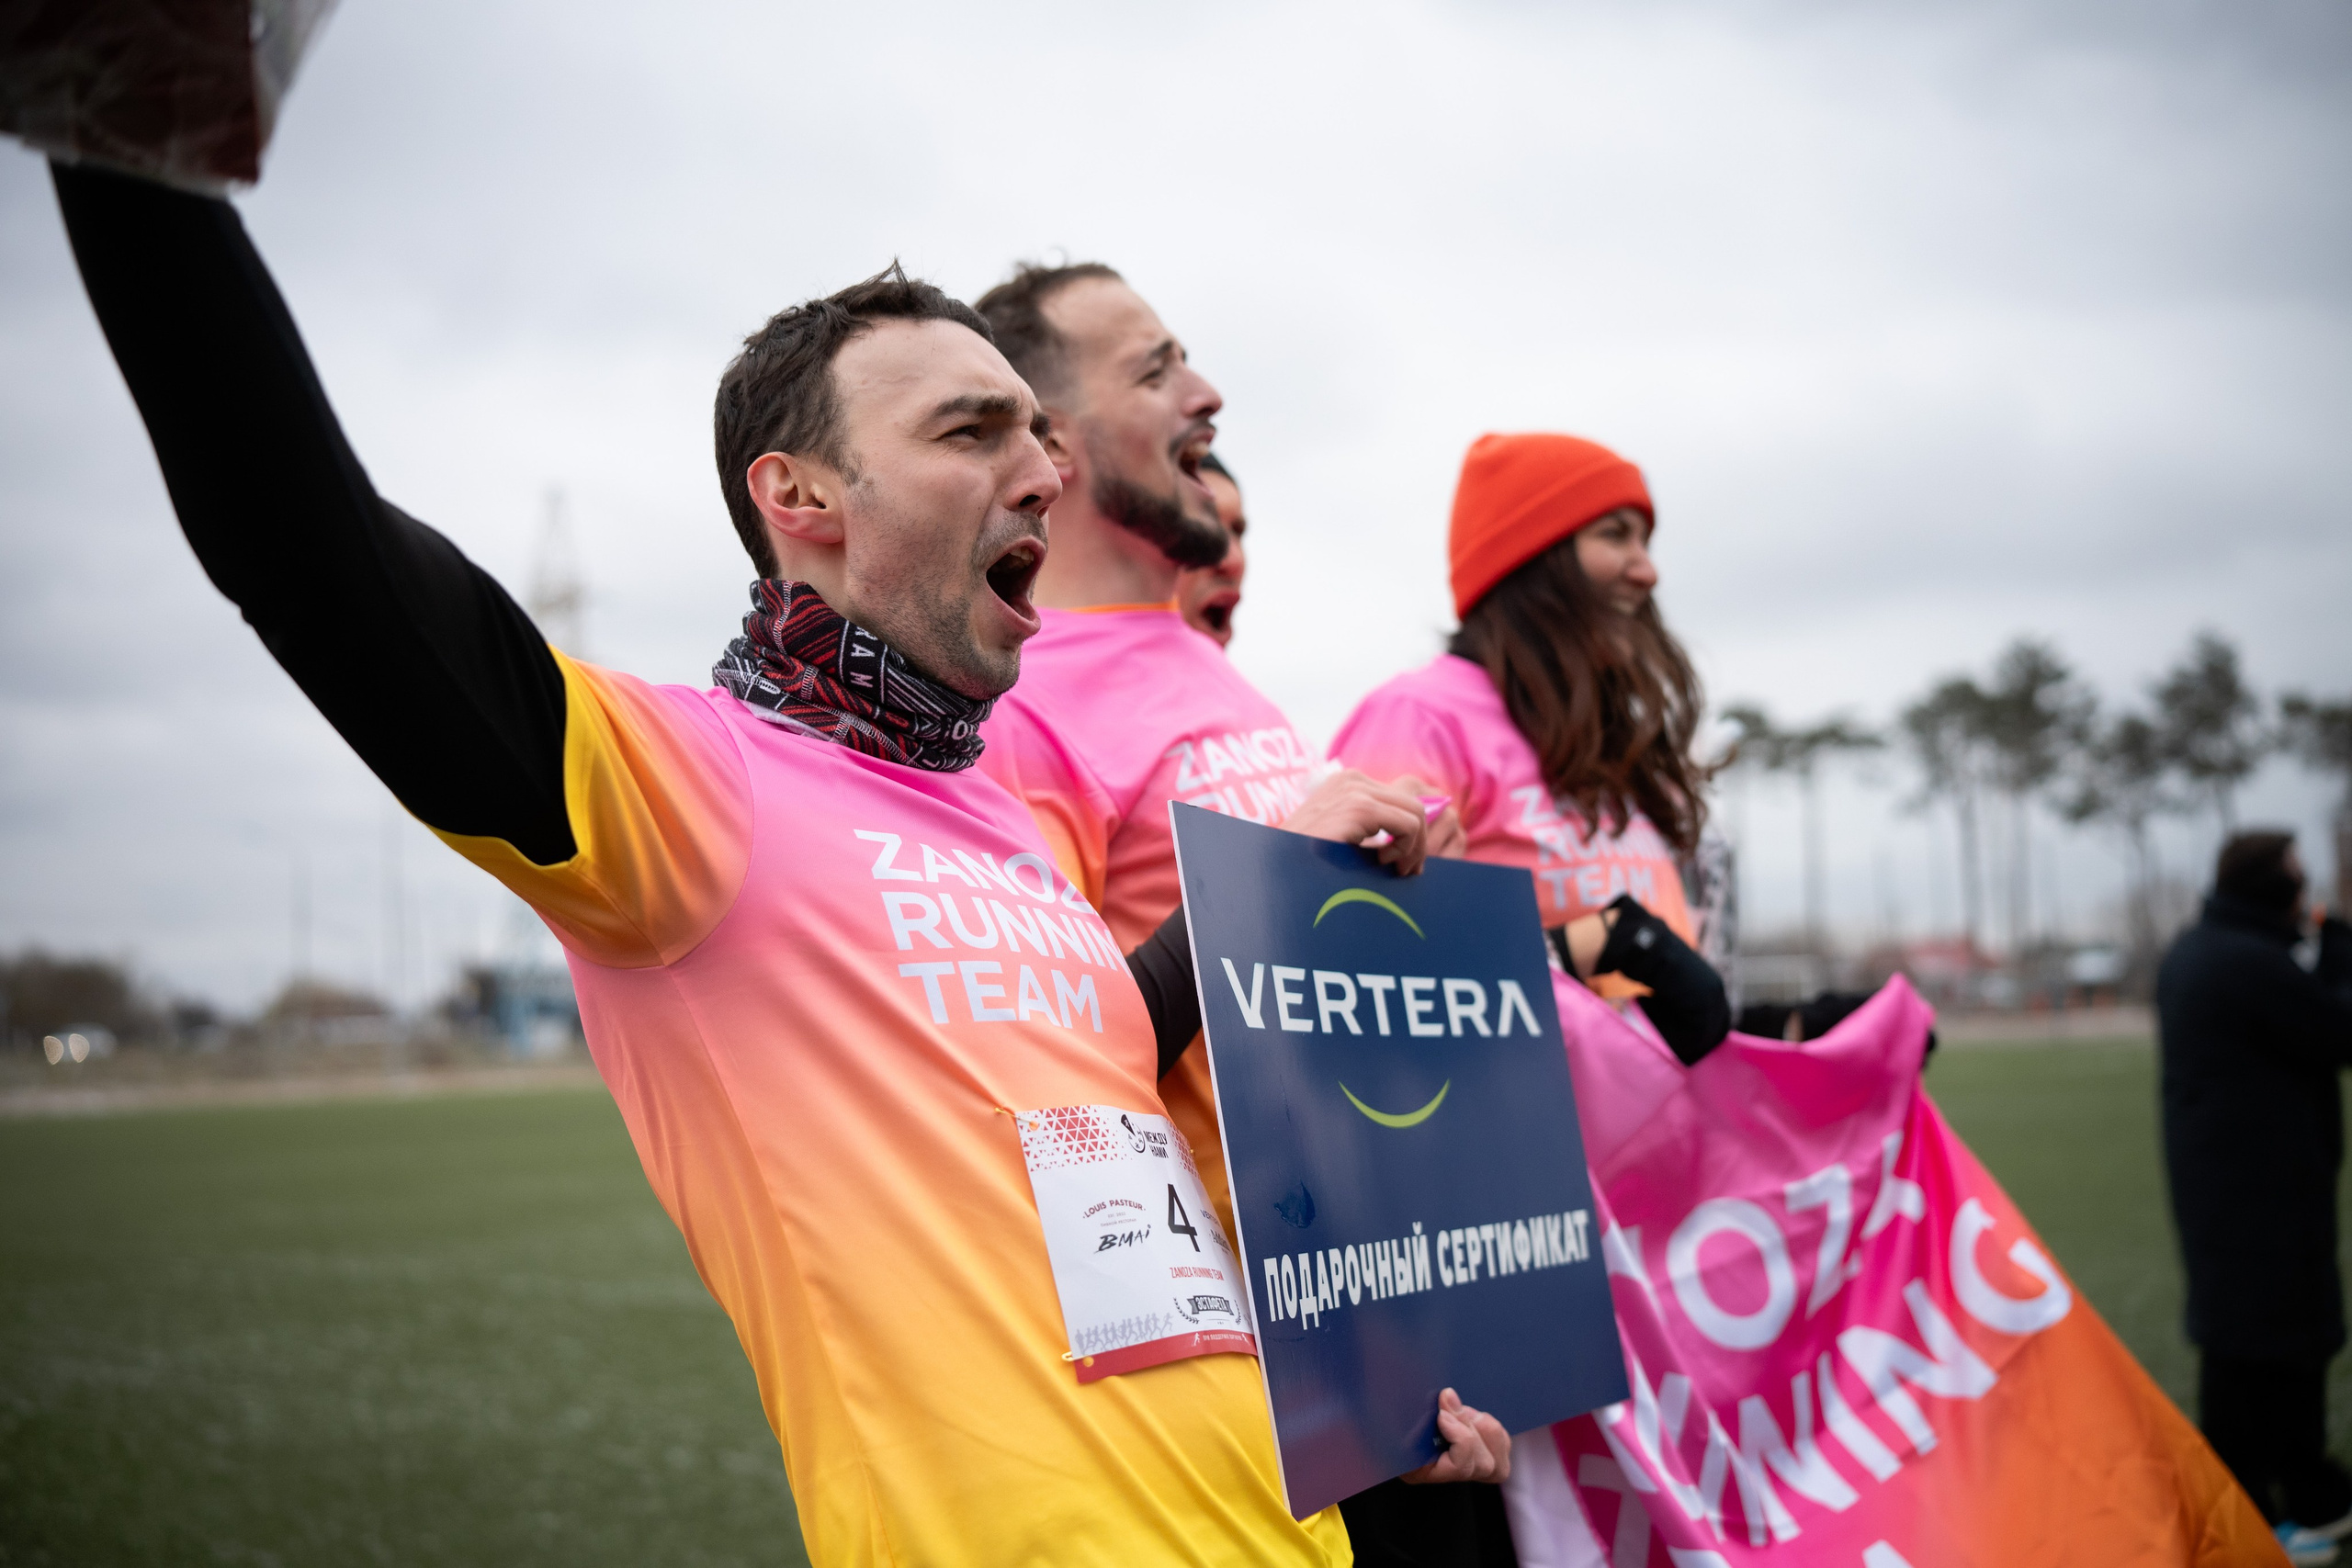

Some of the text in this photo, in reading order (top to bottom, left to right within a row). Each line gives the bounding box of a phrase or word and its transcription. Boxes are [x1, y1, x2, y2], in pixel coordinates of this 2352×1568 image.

[898, 960, 1102, 1033] TEAM
[1220, 957, 1543, 1037] VERTERA
[1168, 1183, 1201, 1253] 4
[1170, 1267, 1193, 1279] ZANOZA
[1194, 1296, 1228, 1312] ЭСТАФЕТА
[1263, 1209, 1589, 1330] ПОДАРОЧНЫЙ СЕРТИФИКАТ
